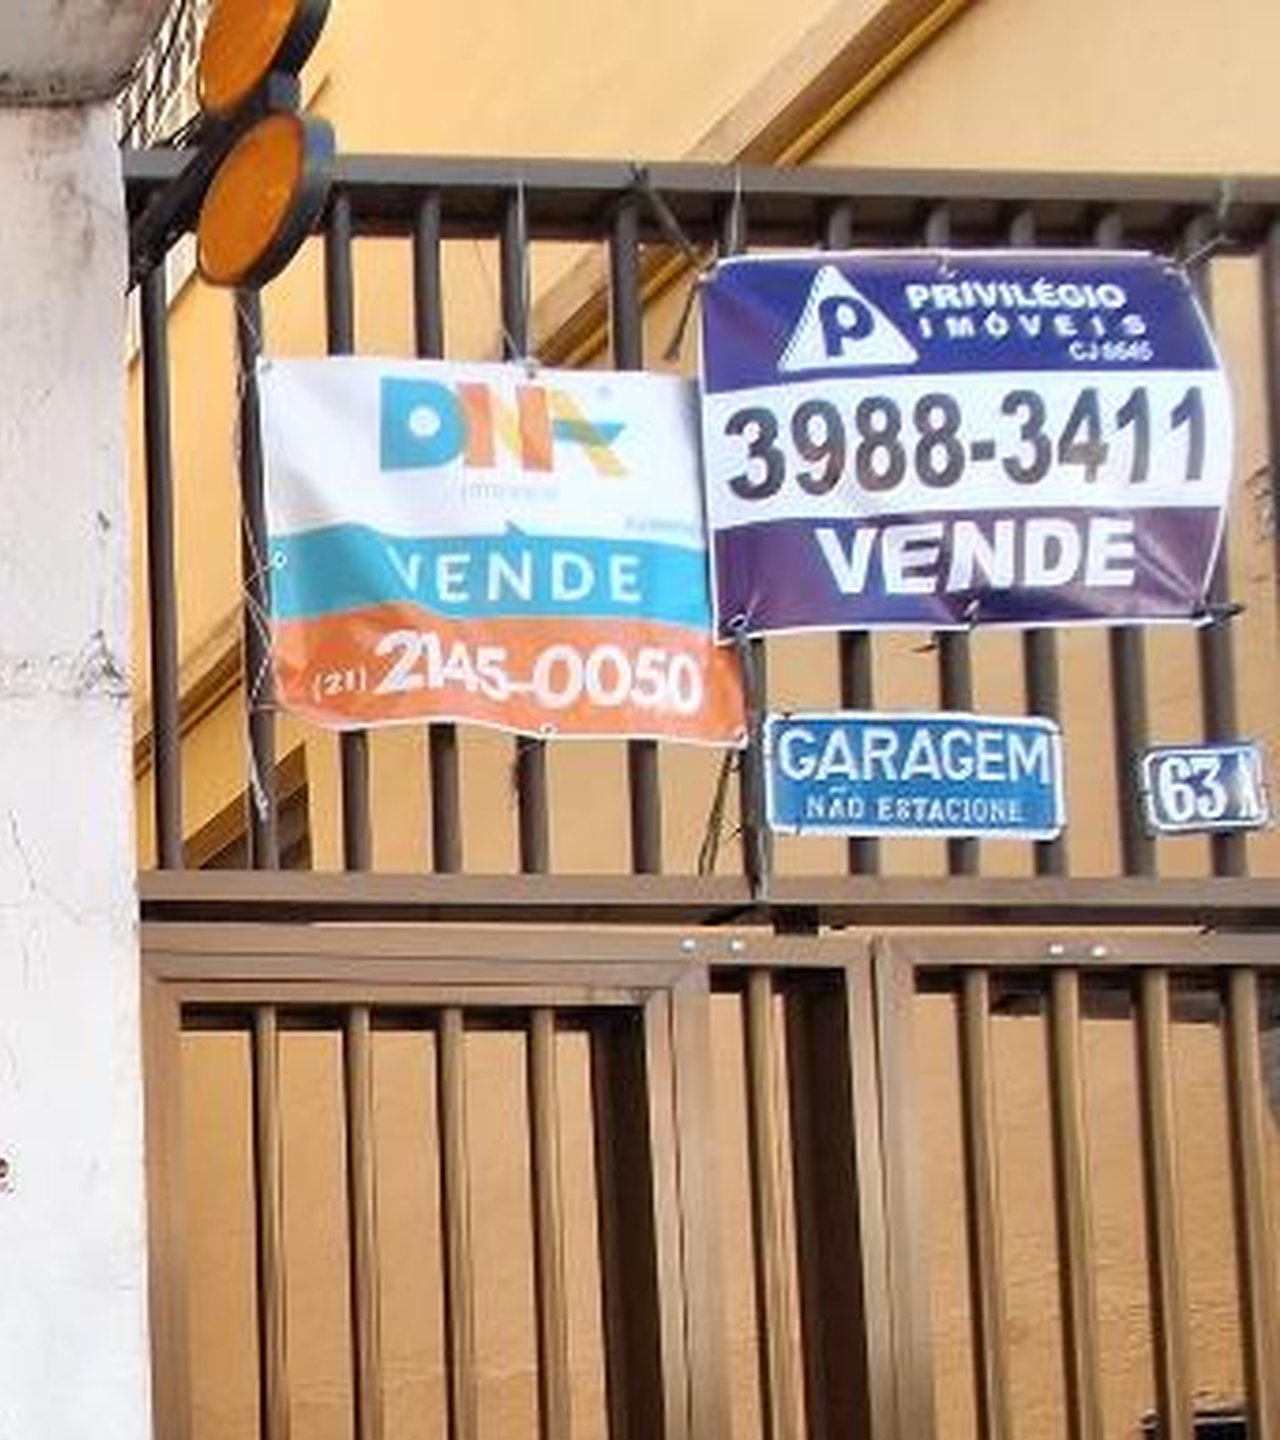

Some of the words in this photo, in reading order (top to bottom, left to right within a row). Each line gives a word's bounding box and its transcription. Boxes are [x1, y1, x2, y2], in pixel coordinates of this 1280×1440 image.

[905, 277, 1127, 310] PRIVILÉGIO
[723, 385, 1206, 501] 3988-3411
[386, 545, 643, 603] VENDE
[814, 517, 1136, 596] VENDE
[313, 666, 368, 703] (21)
[373, 629, 703, 713] 2145-0050
[778, 728, 1053, 785] GARAGEM
[806, 785, 864, 821] NÃO
[878, 796, 1024, 825] ESTACIONE
